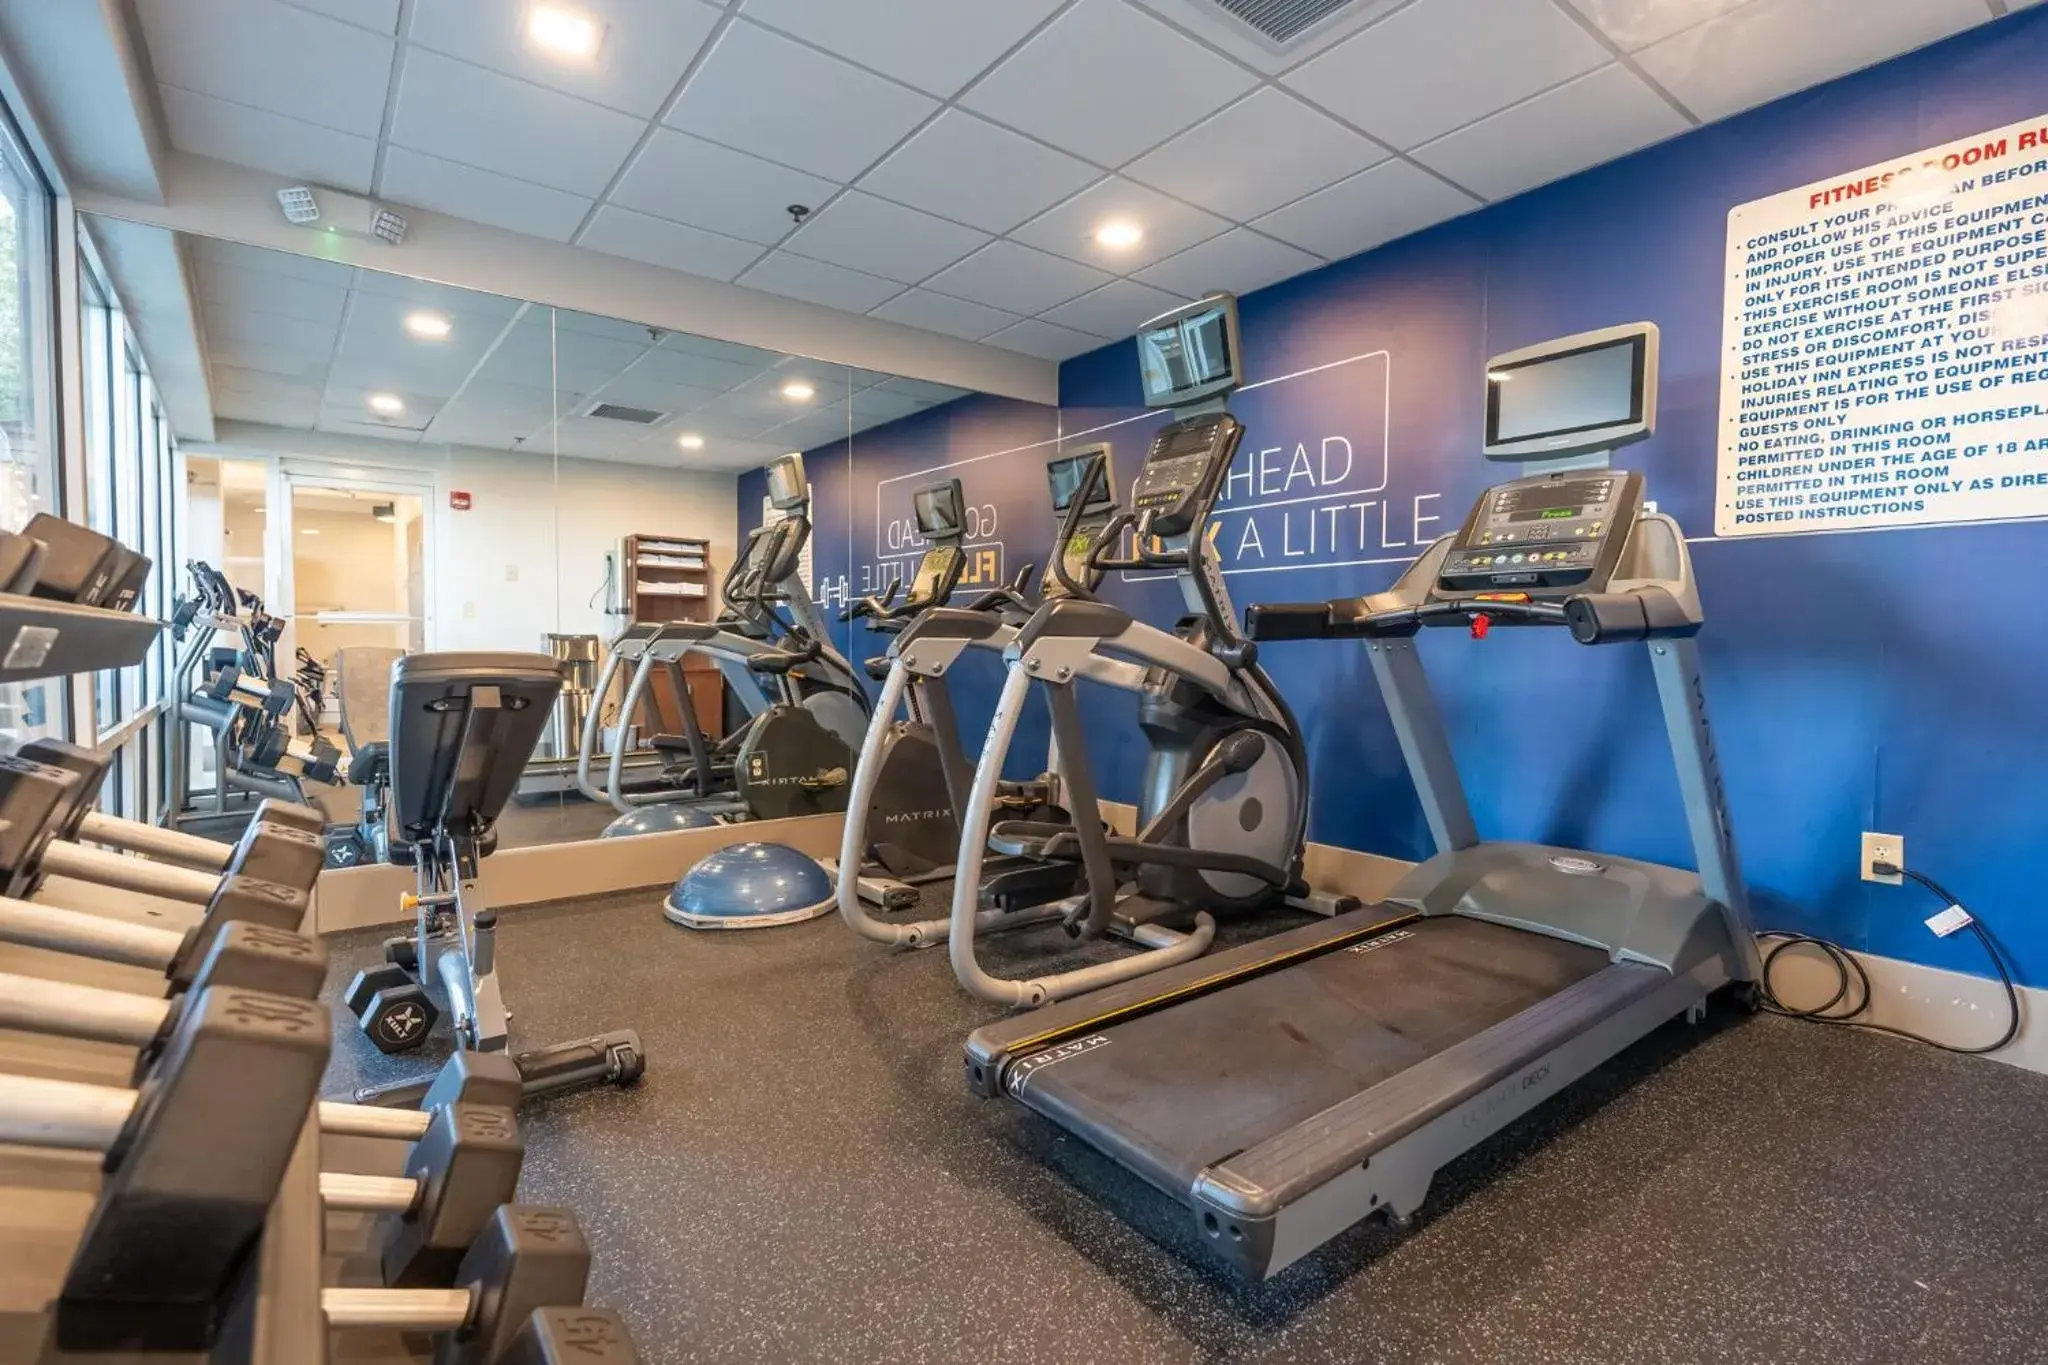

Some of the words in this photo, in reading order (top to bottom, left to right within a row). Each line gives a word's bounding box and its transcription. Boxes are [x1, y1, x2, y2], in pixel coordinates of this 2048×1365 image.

[1923, 139, 2007, 171] OOM
[1746, 251, 1825, 278] IMPROPER
[1831, 241, 1862, 257] USE
[1869, 234, 1890, 247] OF
[1897, 222, 1937, 240] THIS
[1747, 222, 1818, 249] CONSULT
[1824, 209, 1869, 228] YOUR
[1747, 248, 1777, 263] AND
[1783, 230, 1846, 254] FOLLOW
[1853, 221, 1880, 236] HIS
[1886, 202, 1953, 228] ADVICE
[1745, 290, 1784, 307] ONLY
[1791, 283, 1820, 297] FOR
[1827, 275, 1851, 288] ITS
[1858, 254, 1945, 281] INTENDED
[1953, 229, 2046, 260] PURPOSE
[1746, 282, 1760, 292] IN
[1834, 256, 1865, 272] USE
[1872, 247, 1905, 262] THE
[1912, 217, 2024, 253] EQUIPMENT
[1744, 307, 1777, 321] THIS
[1783, 288, 1860, 313] EXERCISE
[1866, 276, 1917, 295] ROOM
[1925, 270, 1941, 283] IS
[1948, 260, 1987, 278] NOT
[1744, 313, 1817, 336] EXERCISE
[1824, 296, 1901, 319] WITHOUT
[1907, 274, 1999, 302] SOMEONE
[1743, 340, 1762, 351] DO
[1768, 332, 1799, 346] NOT
[1804, 314, 1884, 339] EXERCISE
[1891, 309, 1912, 322] AT
[1919, 301, 1953, 316] THE
[1960, 288, 2015, 308] FIRST
[1742, 367, 1769, 380] USE
[1775, 360, 1809, 374] THIS
[1816, 341, 1915, 367] EQUIPMENT
[1921, 335, 1943, 348] AT
[1742, 375, 1807, 394] HOLIDAY
[1814, 369, 1841, 382] INN
[1847, 355, 1924, 377] EXPRESS
[1932, 351, 1949, 363] IS
[1955, 343, 1995, 359] NOT
[1743, 347, 1799, 365] STRESS
[1805, 342, 1826, 353] OR
[1740, 401, 1829, 423] EQUIPMENT
[1835, 399, 1849, 410] IS
[1856, 392, 1889, 406] FOR
[1895, 387, 1929, 401] THE
[1936, 380, 1972, 395] USE
[1979, 376, 2004, 388] OF
[1741, 390, 1811, 409] INJURIES
[1817, 376, 1898, 397] RELATING
[1905, 371, 1928, 383] TO
[1935, 351, 2048, 379] EQUIPMENT
[1738, 441, 1759, 452] NO
[1831, 422, 1914, 440] DRINKING
[1921, 417, 1946, 429] OR
[1740, 421, 1798, 437] GUESTS
[1804, 414, 1847, 429] ONLY
[1218, 437, 1352, 501] HEAD
[1737, 464, 1812, 481] CHILDREN
[1819, 457, 1875, 472] UNDER
[1881, 453, 1915, 467] THE
[1921, 449, 1957, 461] AGE
[1963, 445, 1988, 457] OF
[1997, 442, 2017, 454] 18
[1738, 449, 1824, 466] PERMITTED
[1830, 445, 1846, 456] IN
[1852, 441, 1890, 454] THIS
[1897, 433, 1951, 448] ROOM
[1736, 499, 1764, 509] USE
[1770, 495, 1803, 507] THIS
[1810, 486, 1908, 503] EQUIPMENT
[1914, 481, 1963, 495] ONLY
[1969, 479, 1994, 490] AS
[1737, 479, 1822, 495] PERMITTED
[1829, 476, 1845, 486] IN
[1851, 472, 1888, 484] THIS
[1896, 466, 1949, 480] ROOM
[1237, 517, 1264, 560] A
[1284, 494, 1441, 556] LITTLE
[1736, 511, 1793, 524] POSTED
[1800, 501, 1924, 519] INSTRUCTIONS
[886, 809, 951, 824] MATRIX
[1010, 1035, 1108, 1093] MATRIX
